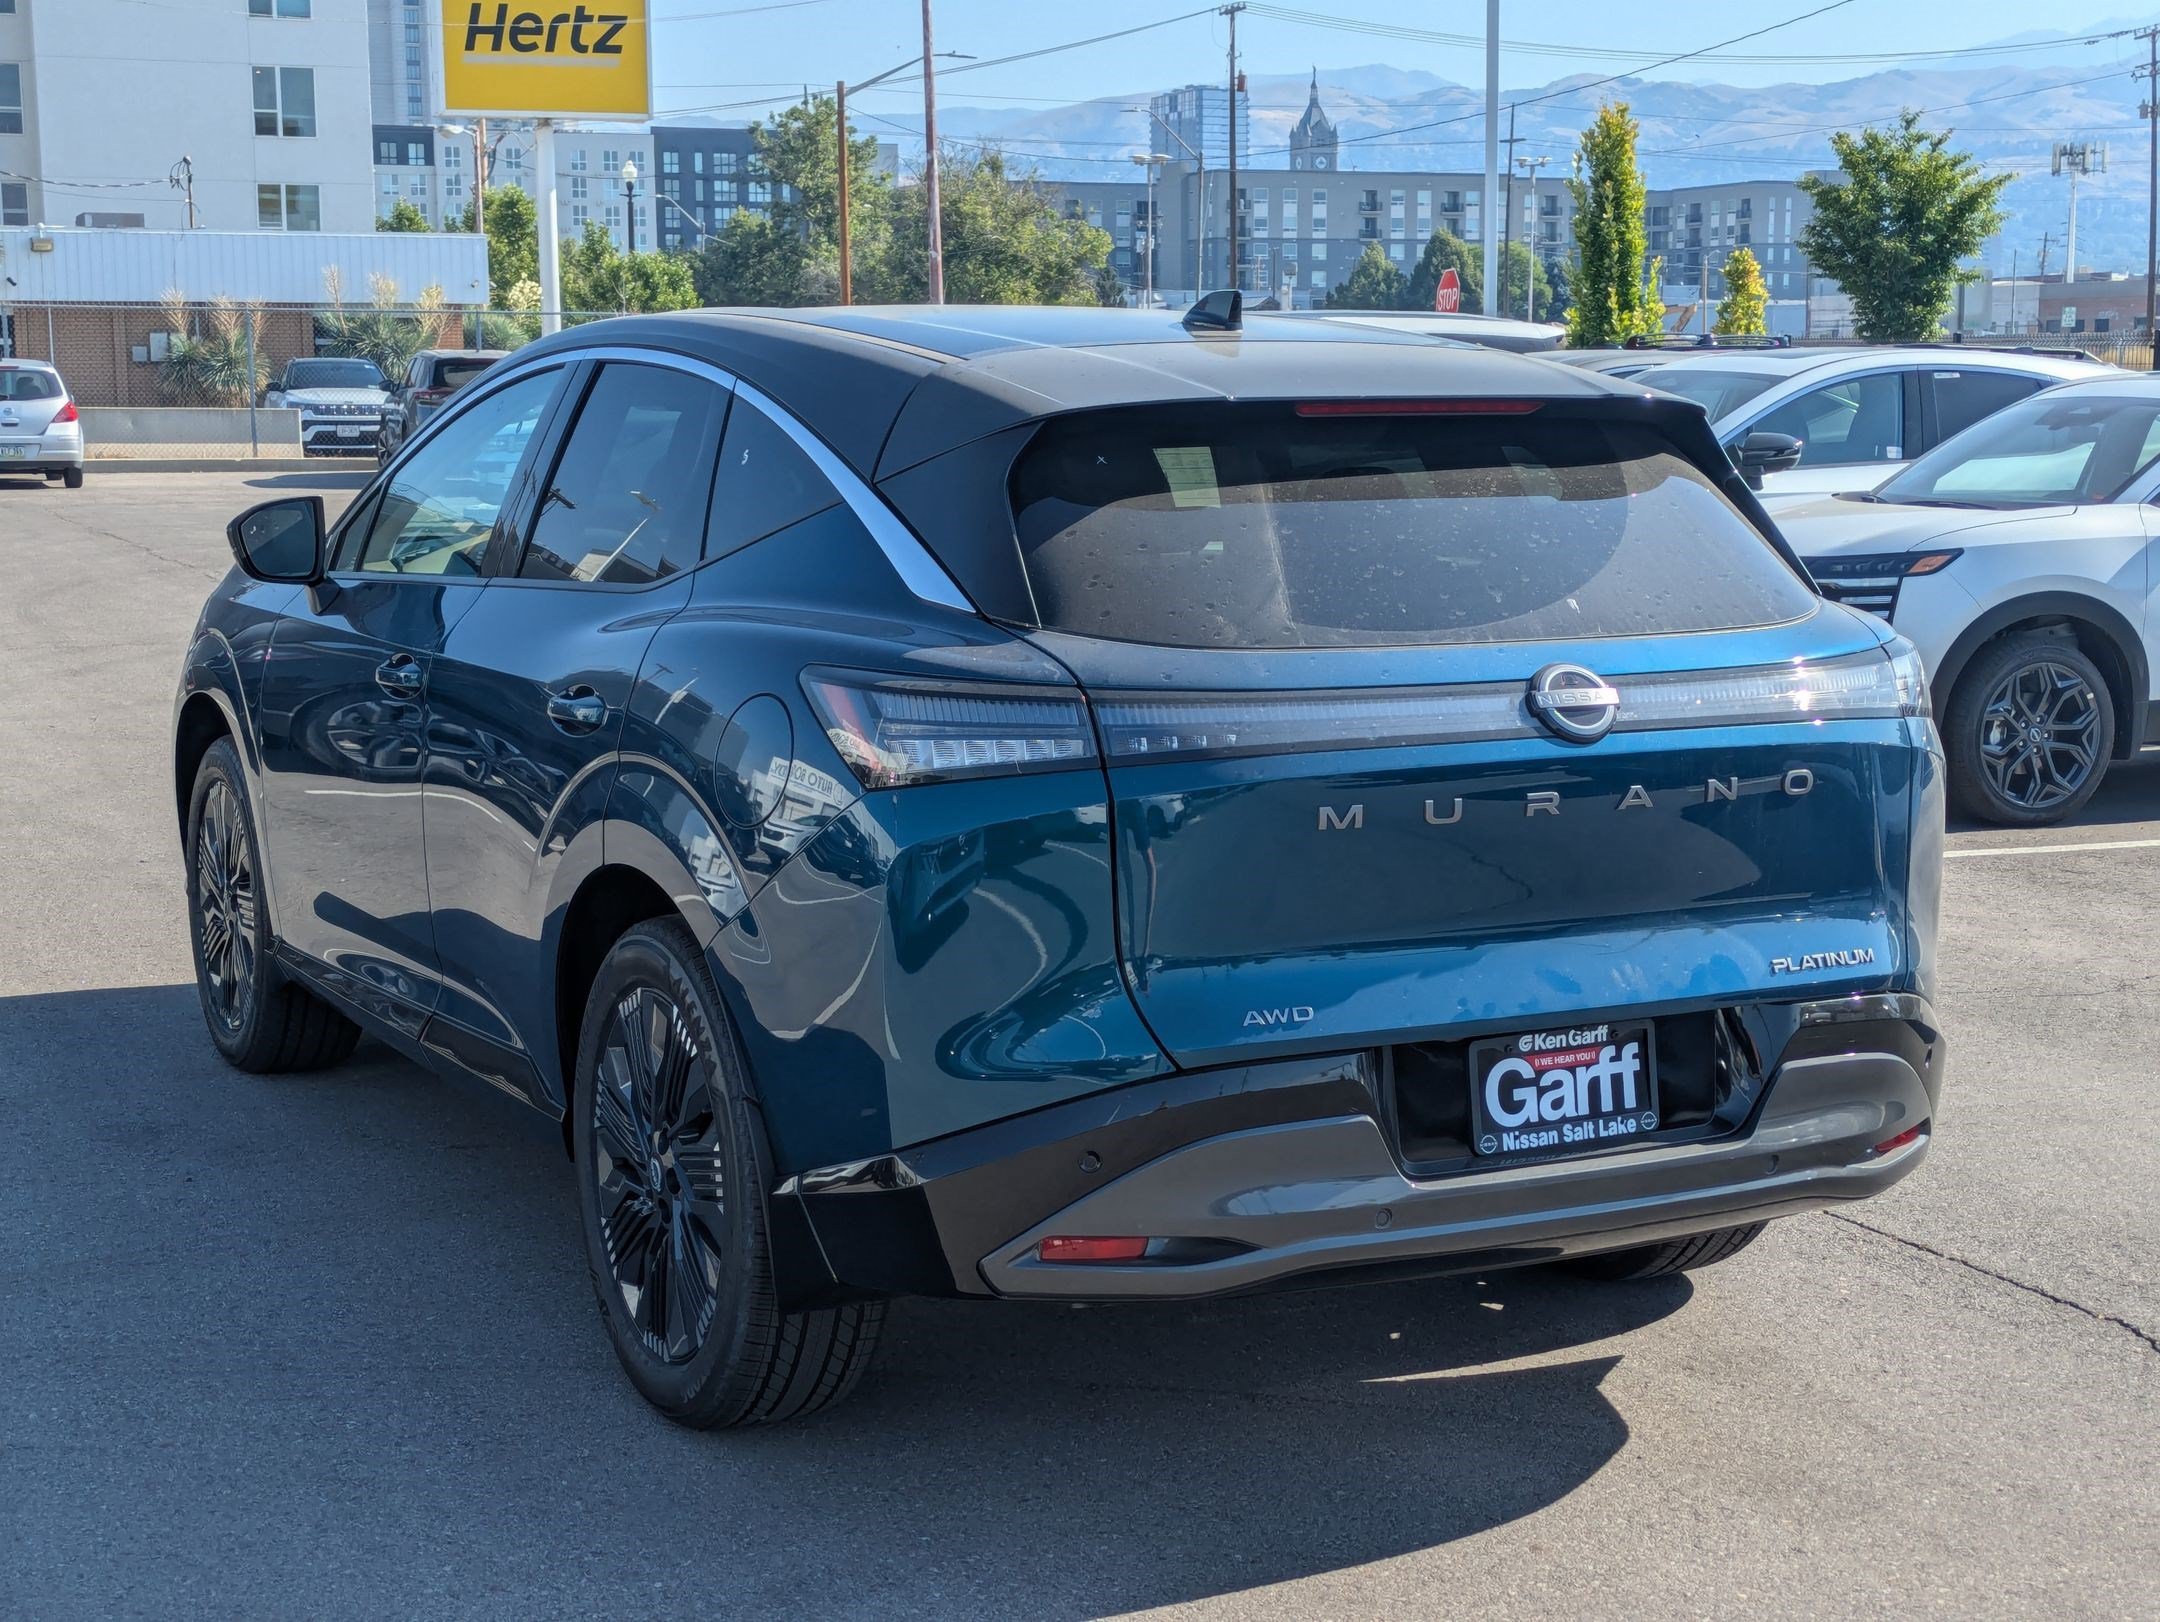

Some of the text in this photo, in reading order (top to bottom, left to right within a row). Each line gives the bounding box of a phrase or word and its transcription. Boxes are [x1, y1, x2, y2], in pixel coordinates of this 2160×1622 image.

[464, 2, 628, 54] Hertz
[1438, 287, 1458, 311] STOP
[1317, 768, 1814, 831] MURANO
[1771, 948, 1875, 974] PLATINUM
[1242, 1006, 1315, 1027] AWD
[1534, 1025, 1609, 1051] Ken Garff
[1540, 1052, 1592, 1066] WE HEAR YOU
[1485, 1041, 1641, 1128] Garff
[1502, 1116, 1637, 1151] Nissan Salt Lake
